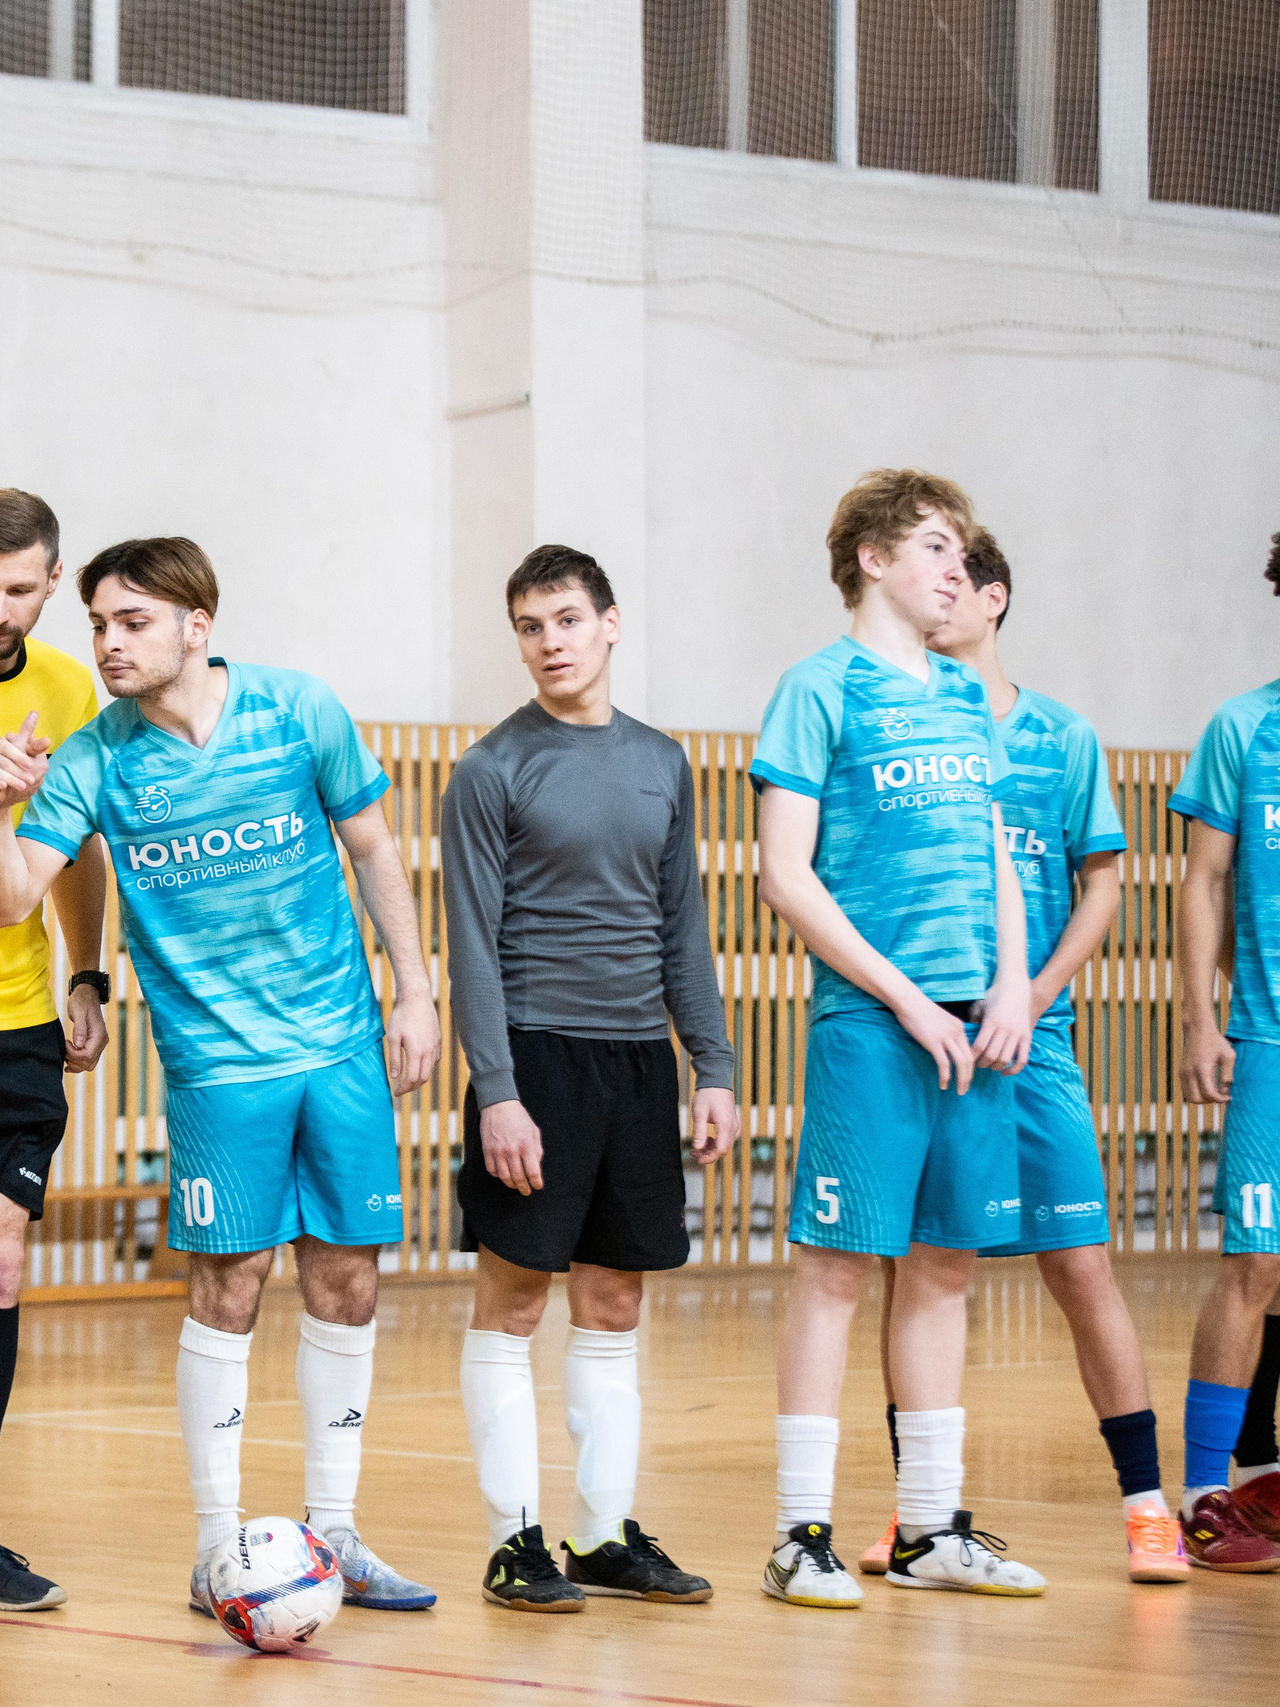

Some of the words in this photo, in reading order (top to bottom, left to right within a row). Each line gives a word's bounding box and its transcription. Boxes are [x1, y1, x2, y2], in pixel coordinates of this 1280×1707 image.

[871, 754, 992, 792] ЮНОСТ
[128, 811, 304, 871] ЮНОСТЬ
[136, 854, 267, 890] спортивный
[272, 837, 306, 868] клуб
[180, 1177, 215, 1227] 10
[816, 1176, 840, 1225] 5
[1054, 1201, 1102, 1214] ЮНОСТЬ
[1240, 1183, 1272, 1229] 11
